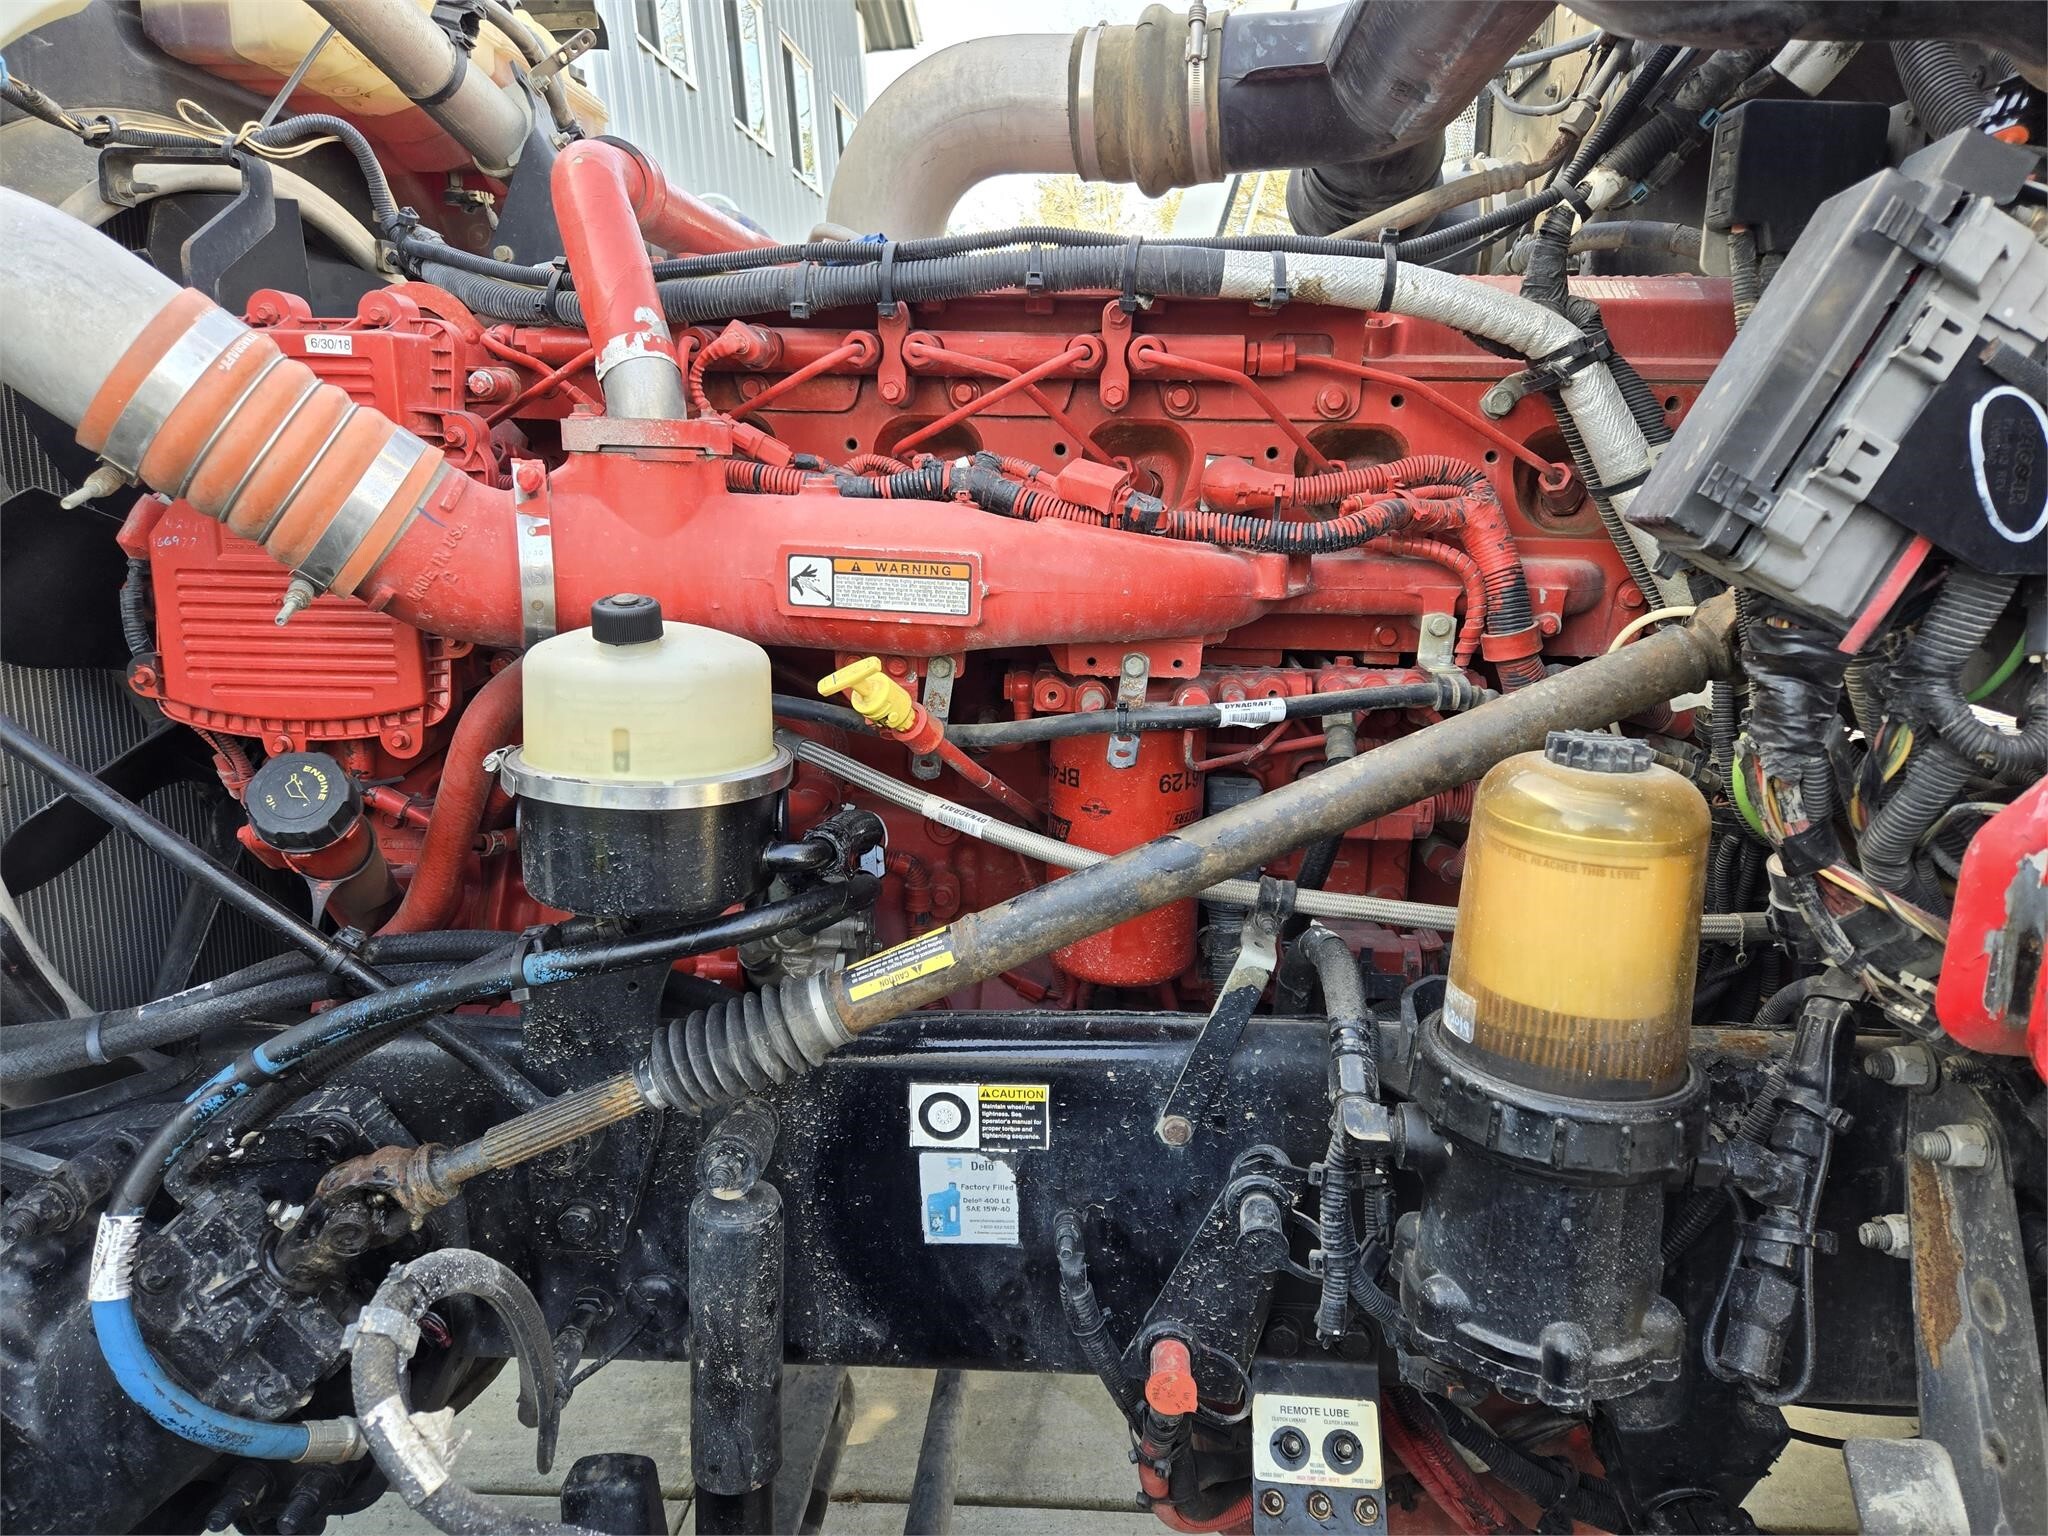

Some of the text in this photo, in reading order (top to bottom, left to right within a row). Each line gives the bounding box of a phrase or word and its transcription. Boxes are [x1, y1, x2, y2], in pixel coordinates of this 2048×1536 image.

[310, 337, 351, 350] 6/30/18
[875, 561, 952, 576] WARNING
[1224, 701, 1272, 710] DYNACRAFT
[302, 765, 328, 801] ENGINE
[939, 803, 988, 824] DYNACRAFT
[879, 971, 910, 988] CAUTION
[992, 1088, 1044, 1099] CAUTION
[1280, 1405, 1350, 1418] REMOTE LUBE
